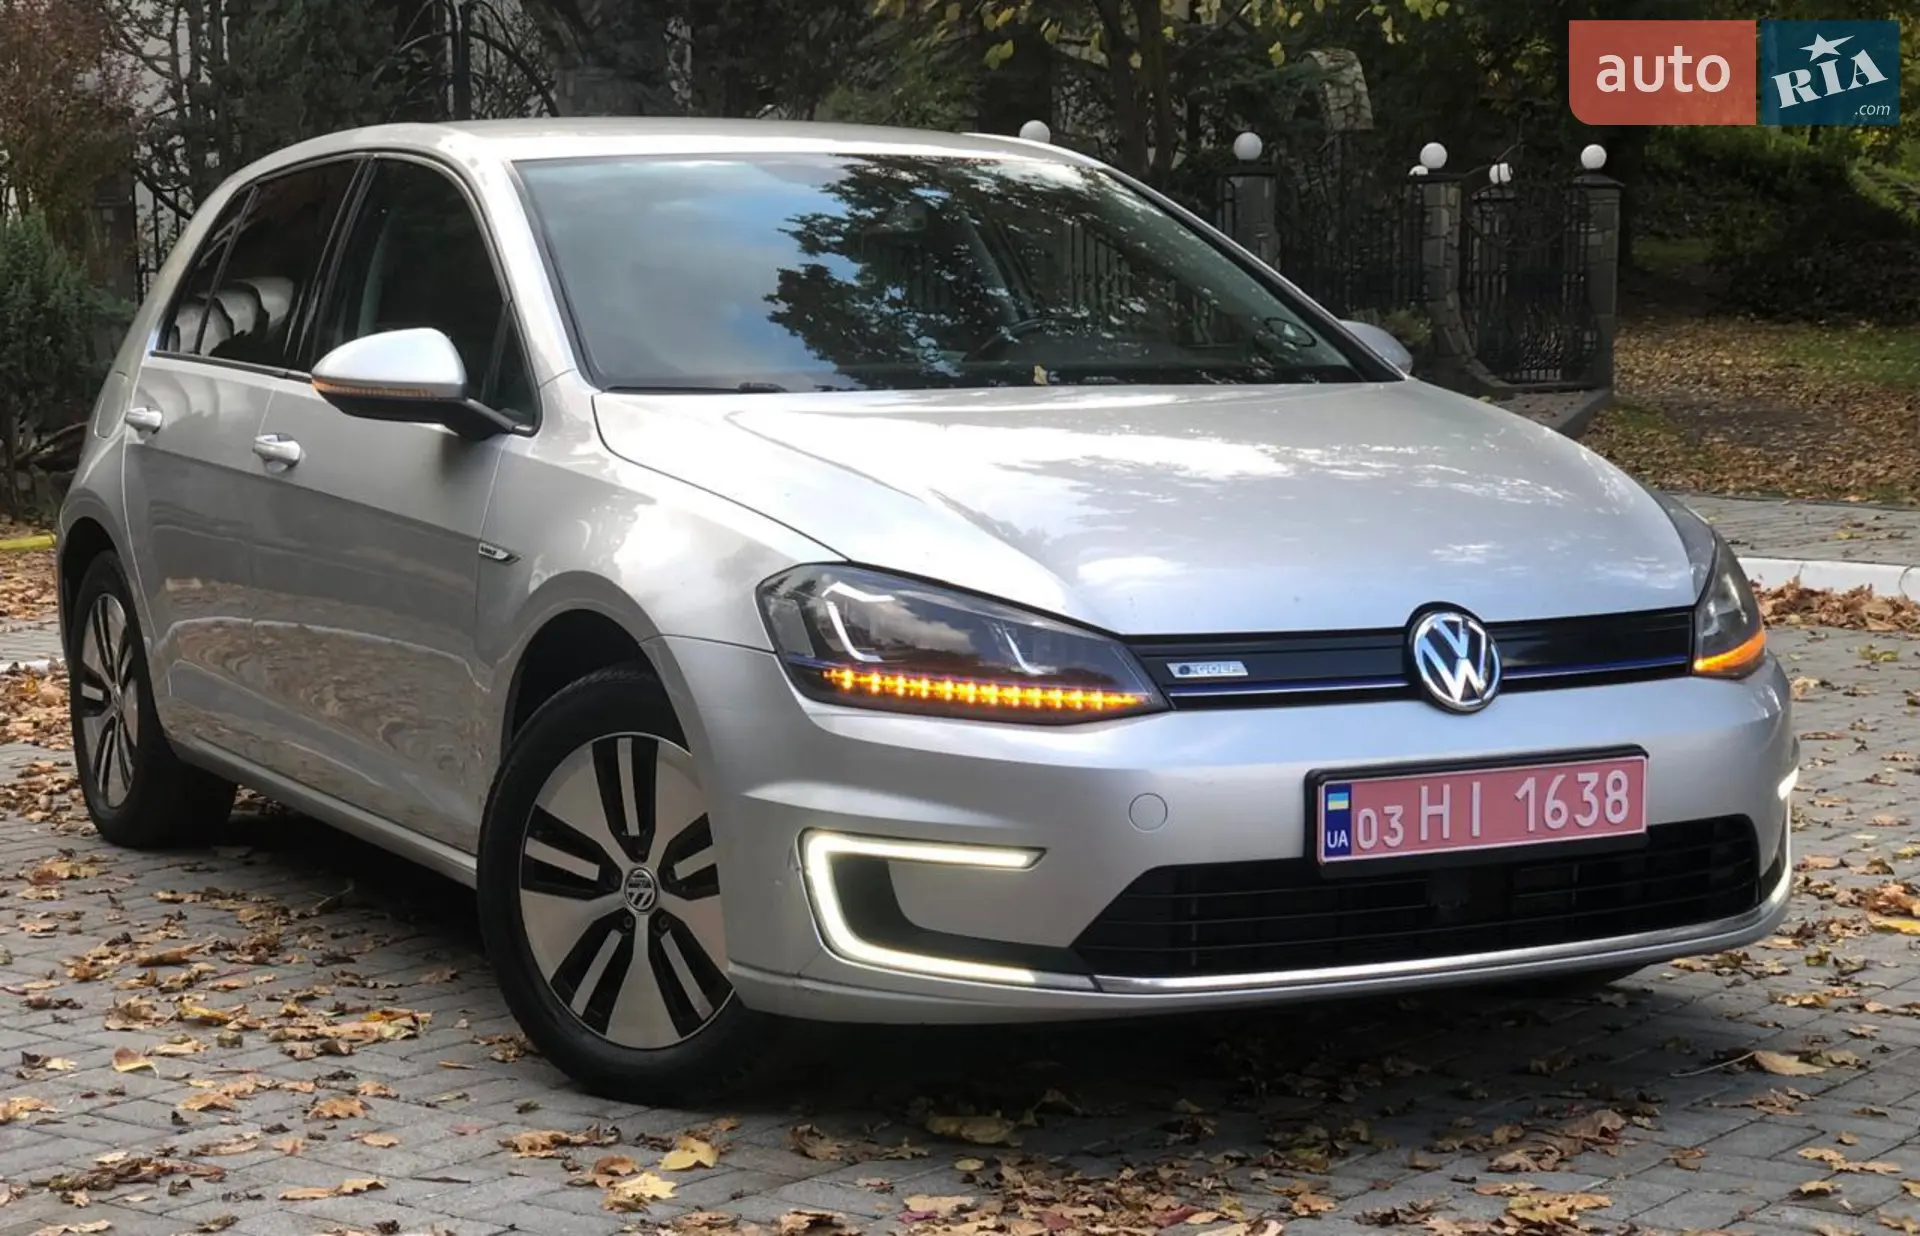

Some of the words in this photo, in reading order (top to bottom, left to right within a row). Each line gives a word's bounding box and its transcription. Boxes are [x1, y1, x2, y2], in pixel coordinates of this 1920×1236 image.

[1326, 830, 1348, 848] UA
[1356, 804, 1405, 850] 03
[1514, 769, 1630, 833] 1638
